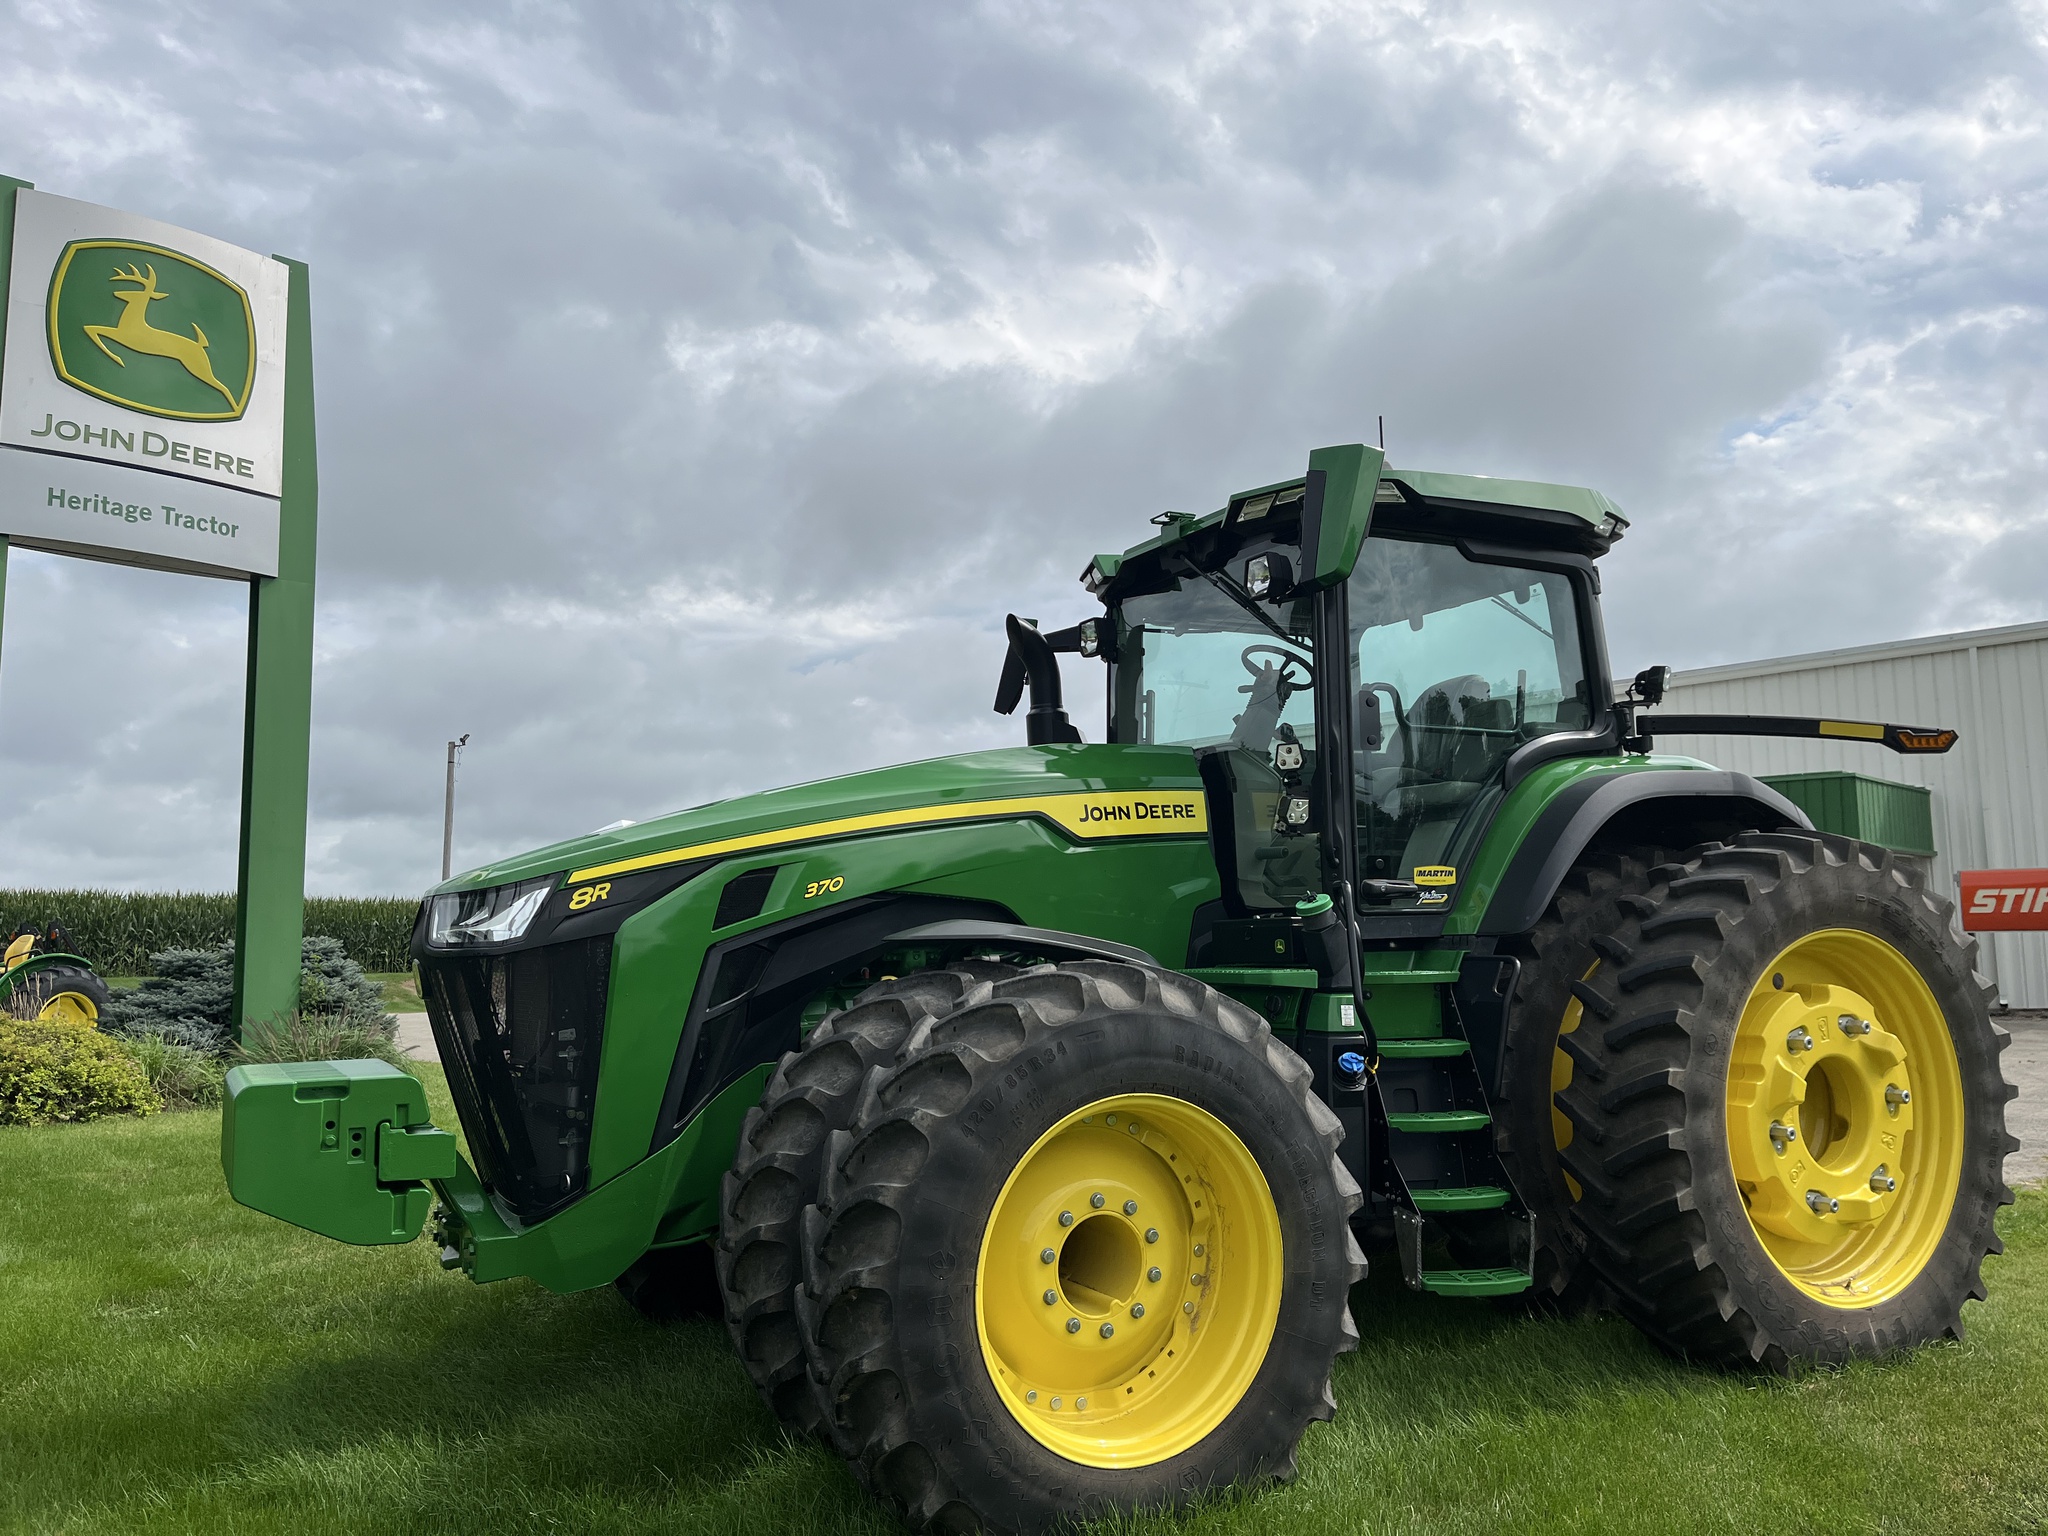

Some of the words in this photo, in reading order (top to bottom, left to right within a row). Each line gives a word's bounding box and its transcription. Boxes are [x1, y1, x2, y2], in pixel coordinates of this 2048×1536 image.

[31, 413, 135, 452] JOHN
[142, 431, 254, 479] DEERE
[47, 487, 152, 523] Heritage
[161, 505, 239, 538] Tractor
[1079, 804, 1132, 822] JOHN
[1134, 802, 1196, 820] DEERE
[803, 876, 845, 899] 370
[1417, 869, 1454, 877] MARTIN
[568, 882, 612, 910] 8R
[960, 1040, 1068, 1138] 420/85R34
[1173, 1044, 1246, 1095] RADIAL
[1284, 1140, 1326, 1262] TRACTION
